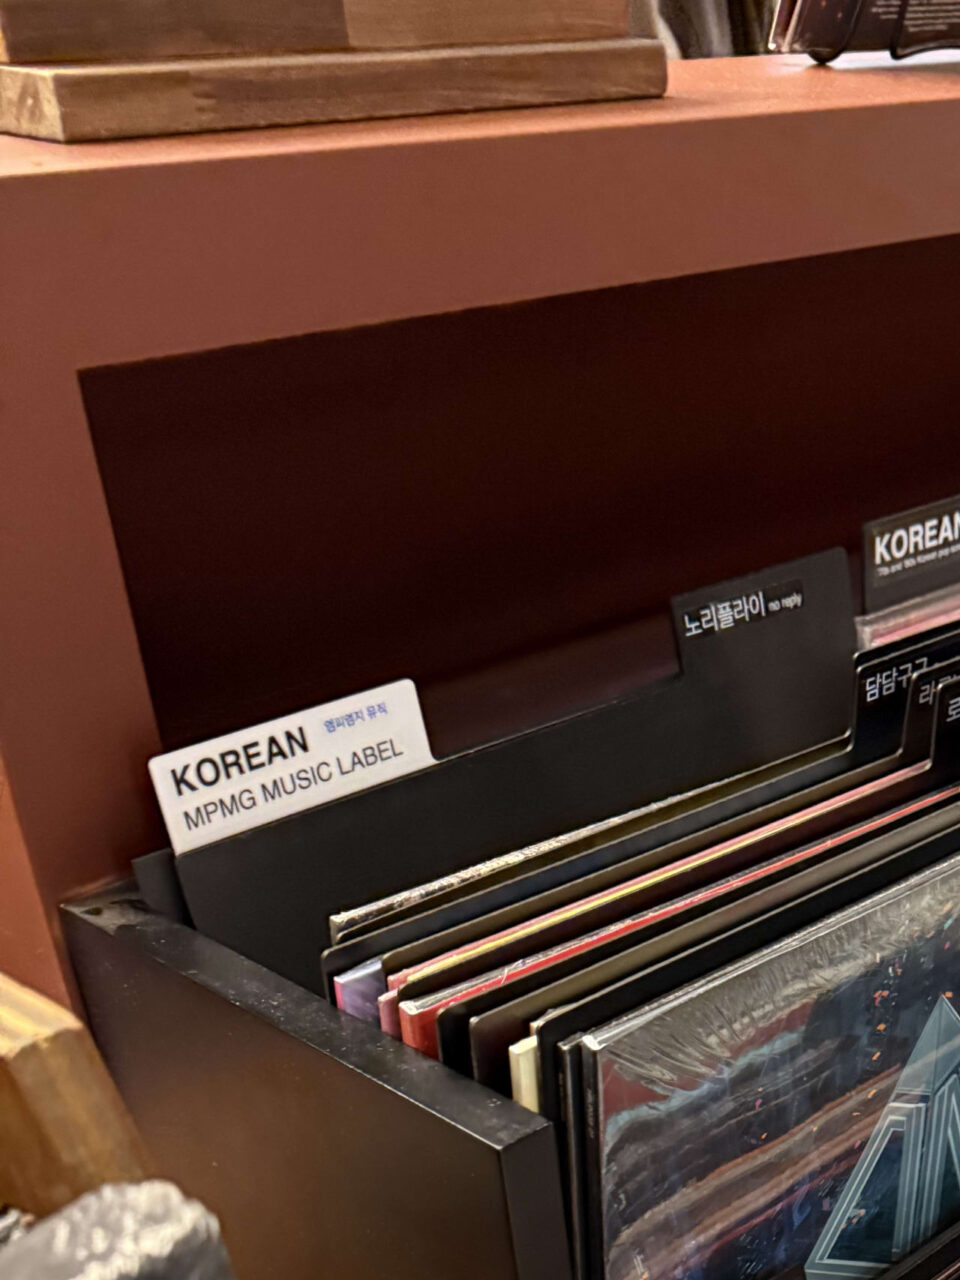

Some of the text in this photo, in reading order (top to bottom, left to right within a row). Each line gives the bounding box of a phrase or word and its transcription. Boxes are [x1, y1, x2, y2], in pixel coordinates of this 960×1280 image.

[684, 590, 767, 637] 노리플라이
[366, 702, 388, 719] 뮤직
[170, 726, 310, 796] KOREAN
[183, 737, 404, 831] MPMG MUSIC LABEL
